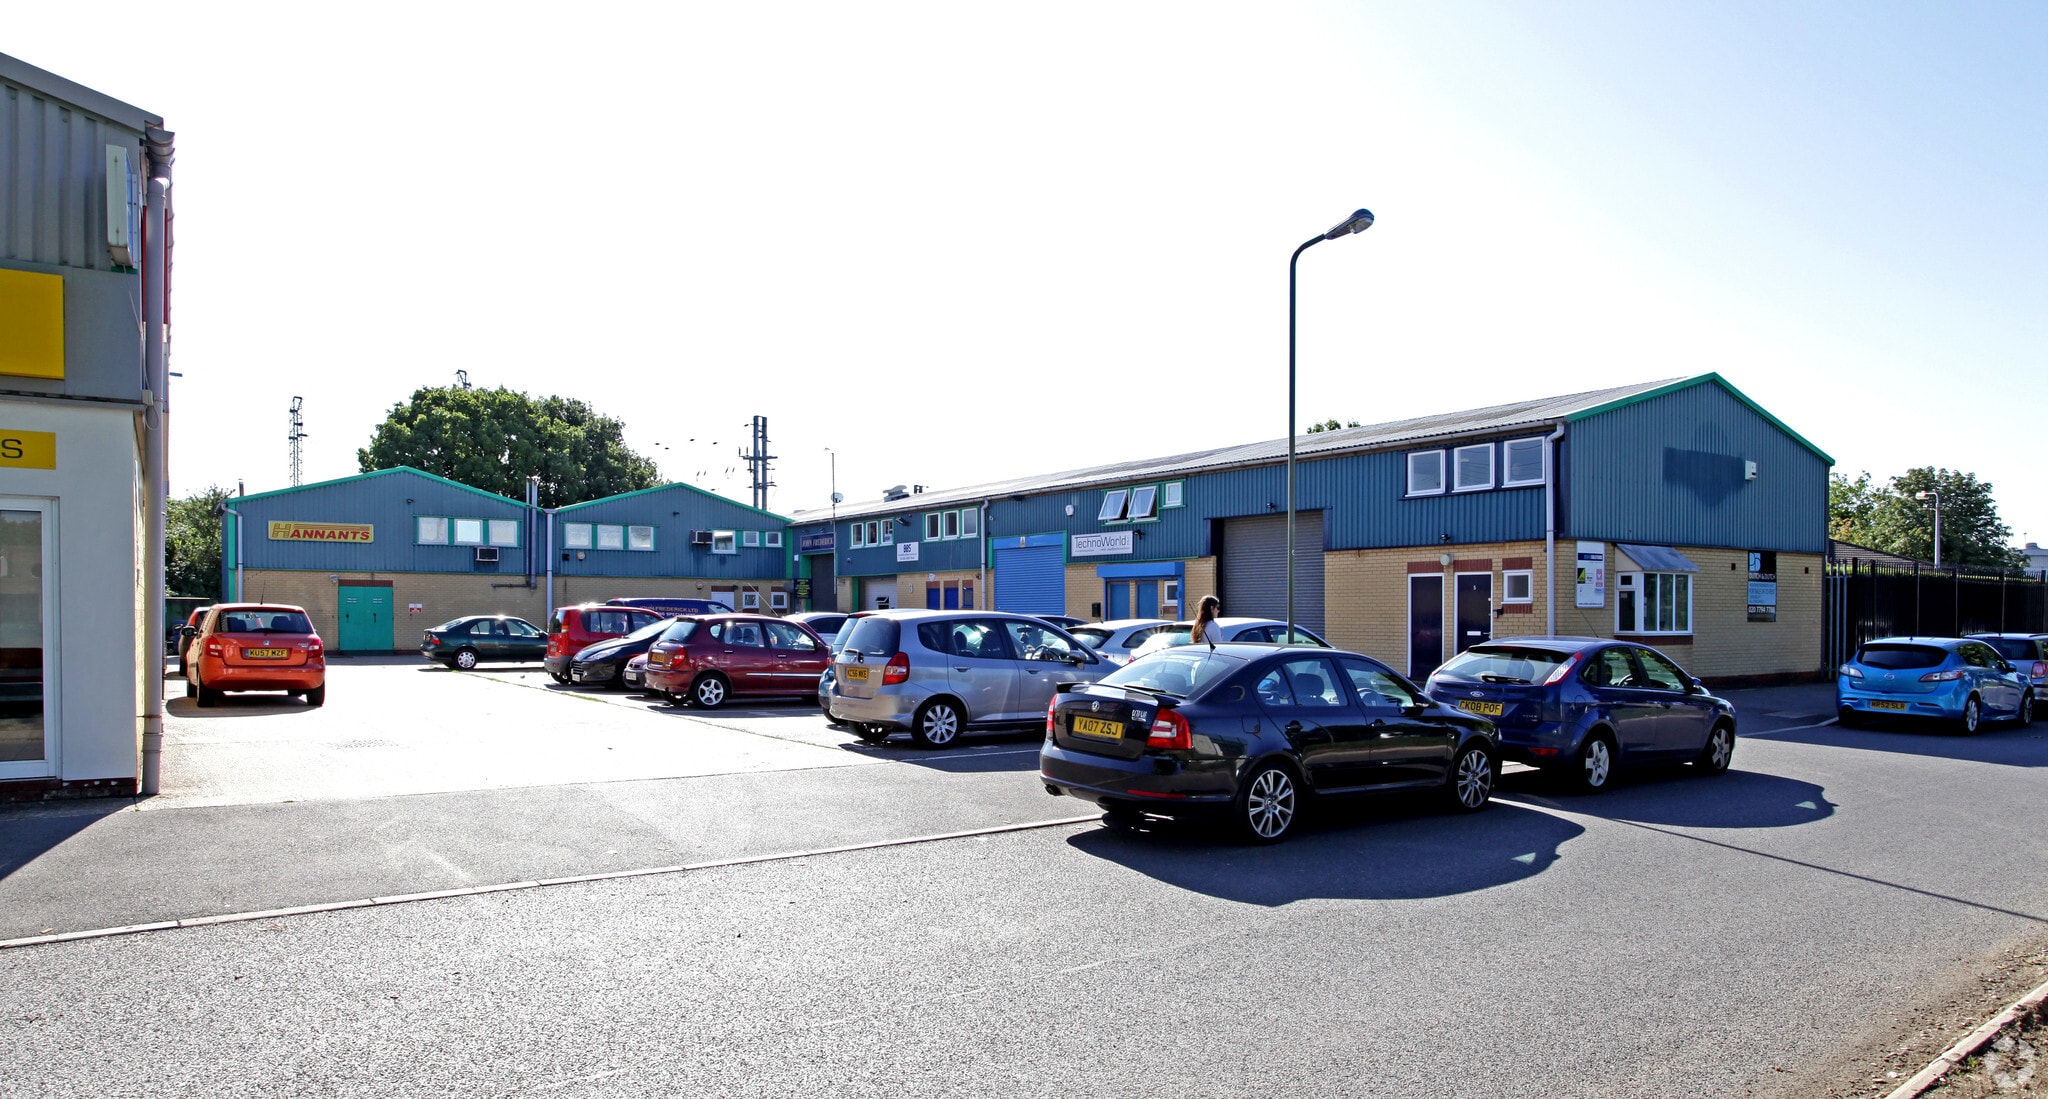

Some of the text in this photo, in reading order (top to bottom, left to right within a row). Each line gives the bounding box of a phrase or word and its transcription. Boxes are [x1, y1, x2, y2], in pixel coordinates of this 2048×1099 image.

[272, 523, 370, 540] HANNANTS
[1074, 535, 1127, 548] TechnoWorld
[1484, 703, 1501, 713] POF
[1078, 719, 1119, 735] YA07 ZSJ
